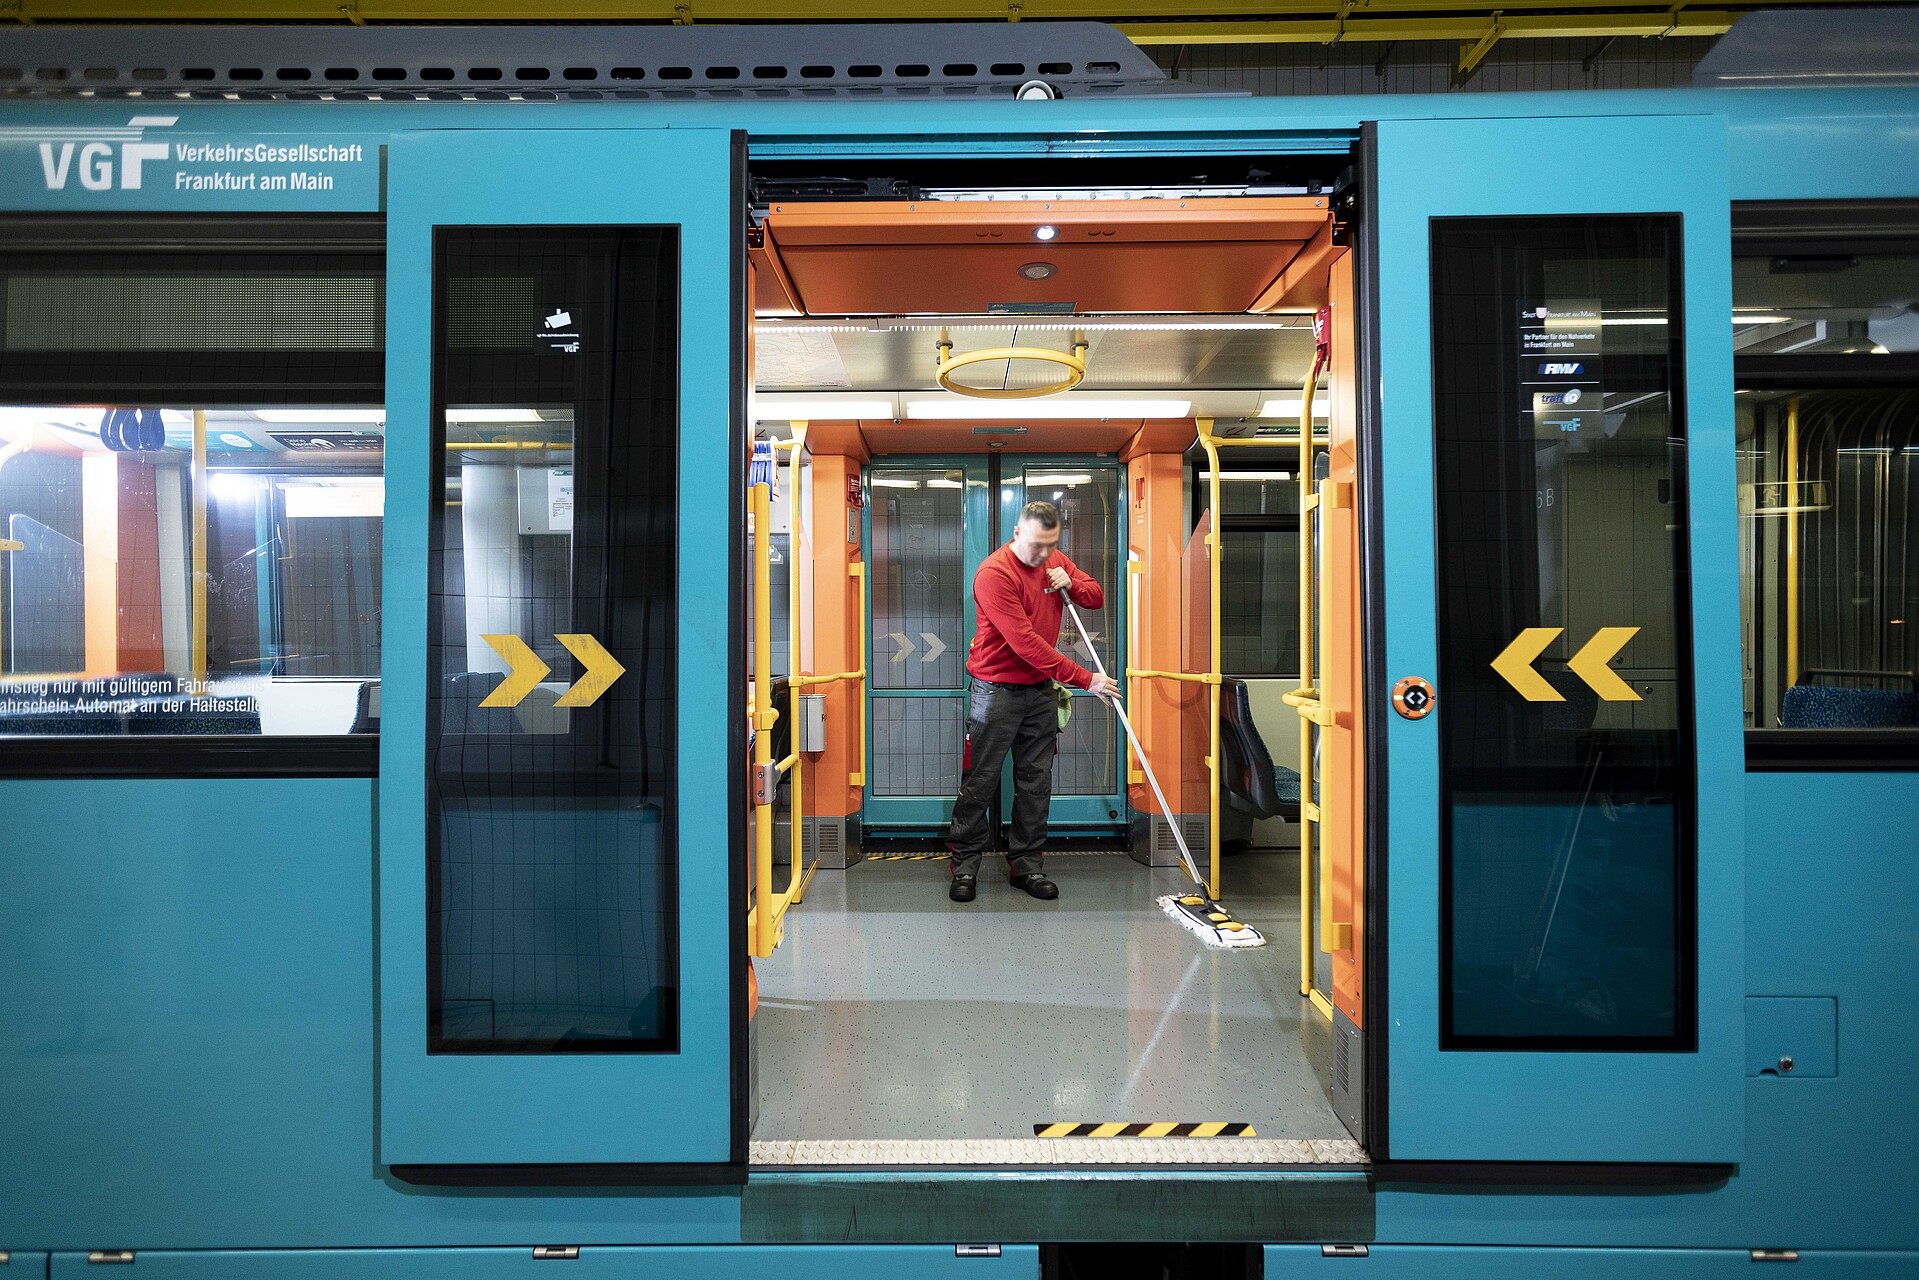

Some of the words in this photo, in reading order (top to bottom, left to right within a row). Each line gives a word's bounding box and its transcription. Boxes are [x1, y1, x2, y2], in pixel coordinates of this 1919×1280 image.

[39, 116, 179, 190] VGF
[176, 143, 363, 163] VerkehrsGesellschaft
[175, 172, 256, 190] Frankfurt
[260, 175, 287, 190] am
[290, 172, 334, 190] Main
[1544, 363, 1580, 374] RMV
[1561, 417, 1581, 432] VGF
[0, 680, 48, 697] instieg
[53, 681, 78, 694] nur
[82, 679, 106, 694] mit
[109, 678, 172, 696] gültigem
[0, 697, 138, 713] ahrschein-Automat
[140, 700, 158, 713] an
[162, 698, 186, 713] der
